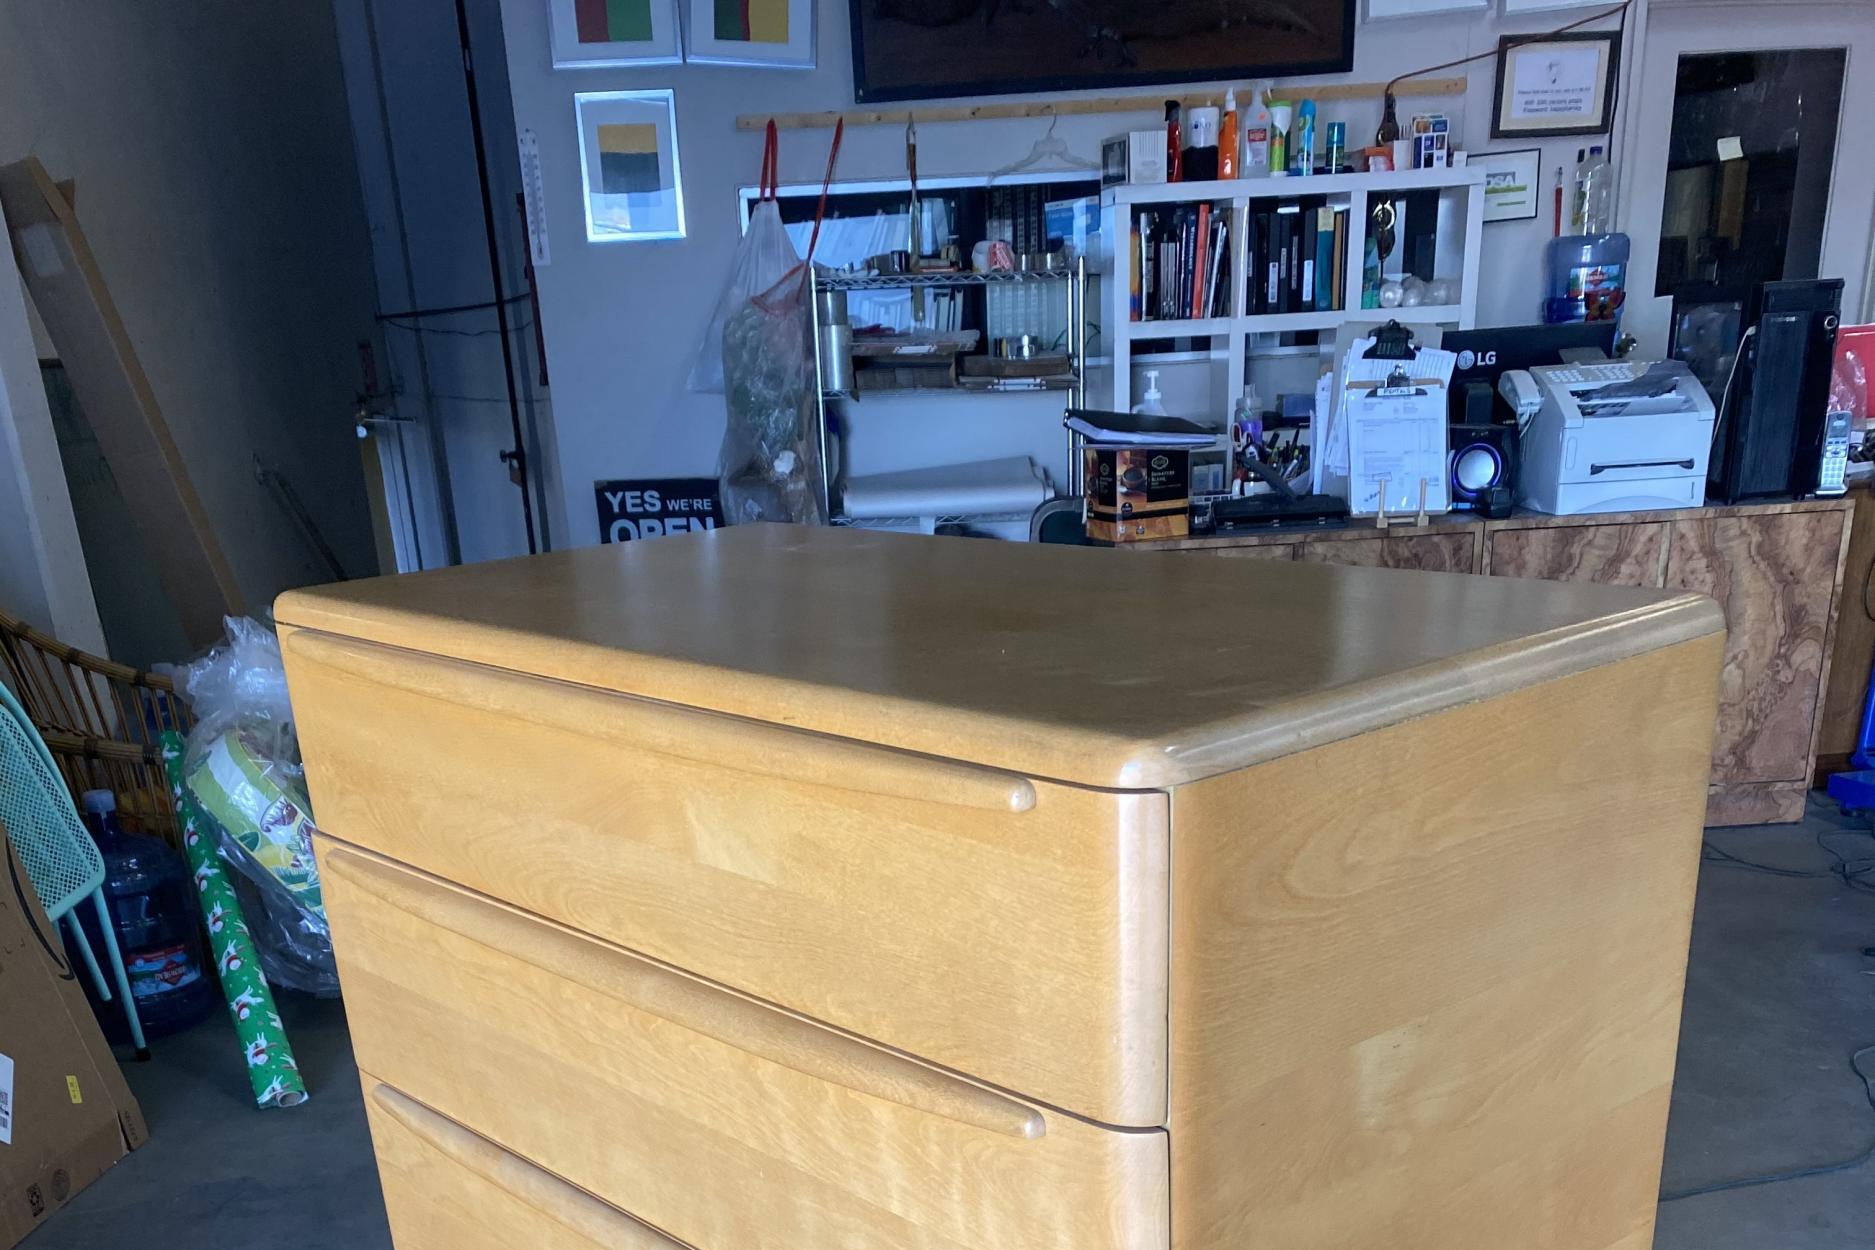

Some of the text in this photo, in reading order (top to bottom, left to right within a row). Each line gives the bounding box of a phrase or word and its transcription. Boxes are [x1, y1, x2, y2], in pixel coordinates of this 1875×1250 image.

[1477, 352, 1496, 365] LG
[604, 490, 712, 513] YES WE'RE
